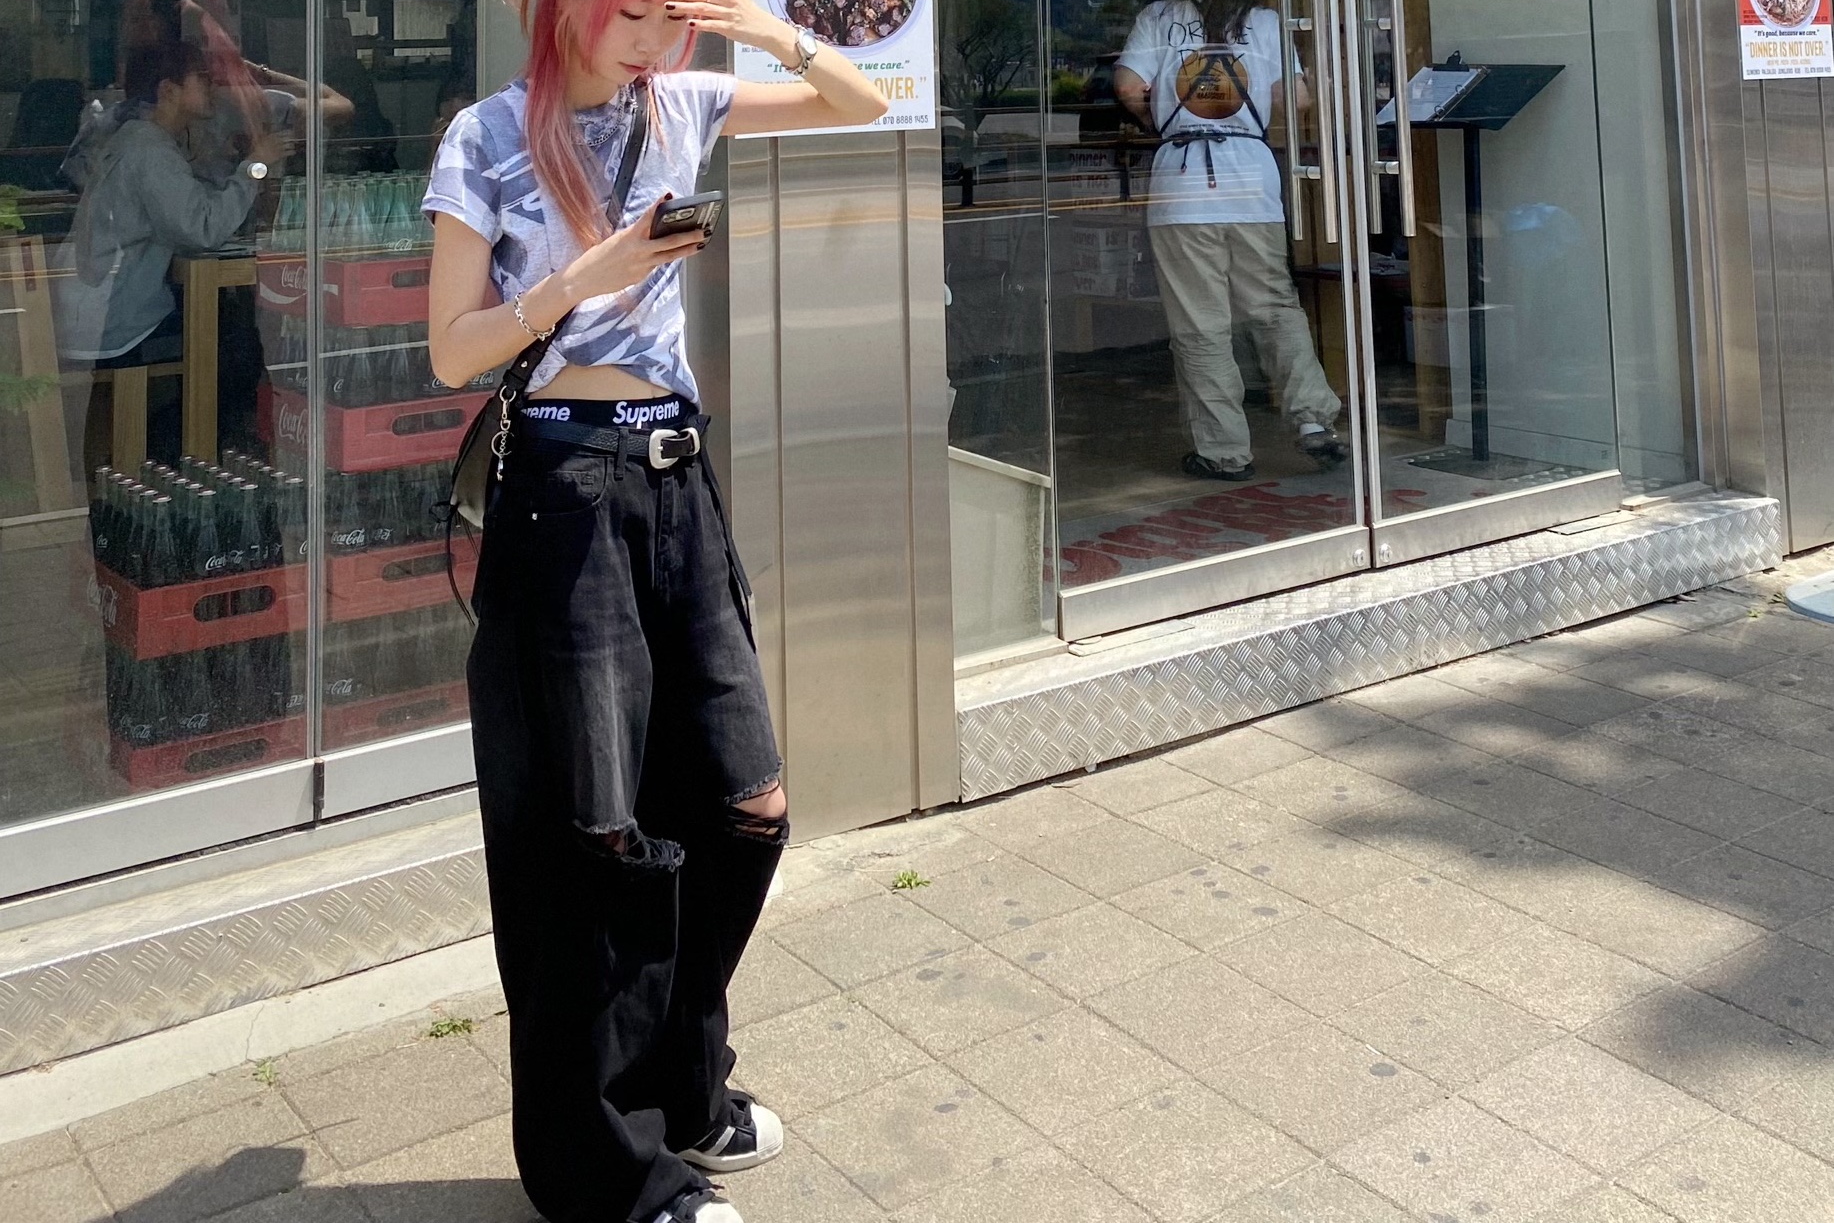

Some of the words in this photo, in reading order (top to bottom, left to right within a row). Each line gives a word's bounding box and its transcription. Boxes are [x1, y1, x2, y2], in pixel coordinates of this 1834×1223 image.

[1779, 41, 1787, 57] IS
[1788, 40, 1803, 57] NOT
[896, 116, 913, 124] 8888
[914, 114, 929, 124] 1455
[612, 399, 680, 429] Supreme
